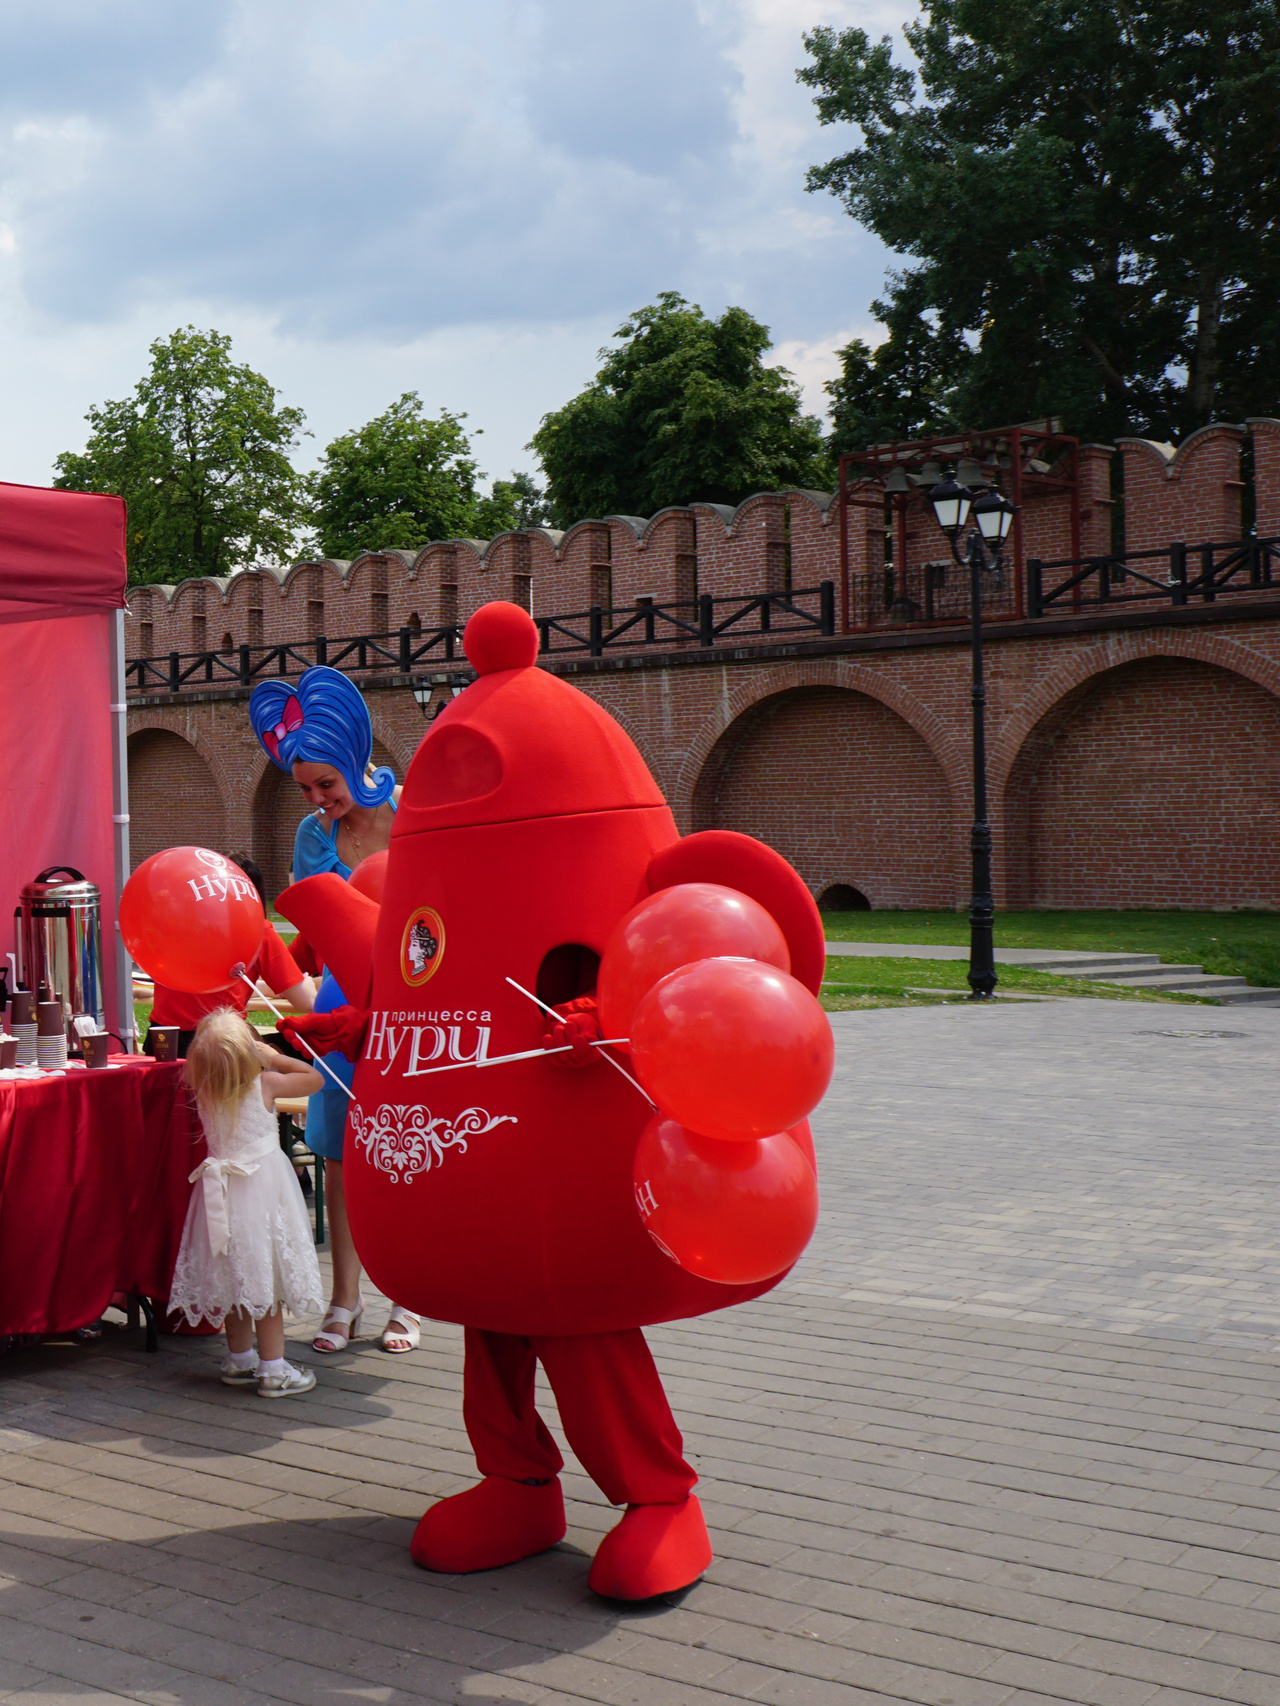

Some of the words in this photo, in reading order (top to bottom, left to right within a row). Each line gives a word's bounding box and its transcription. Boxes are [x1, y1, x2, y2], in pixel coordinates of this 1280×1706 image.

[186, 874, 260, 903] Нури
[391, 1010, 492, 1024] принцесса
[365, 1011, 491, 1076] Нури
